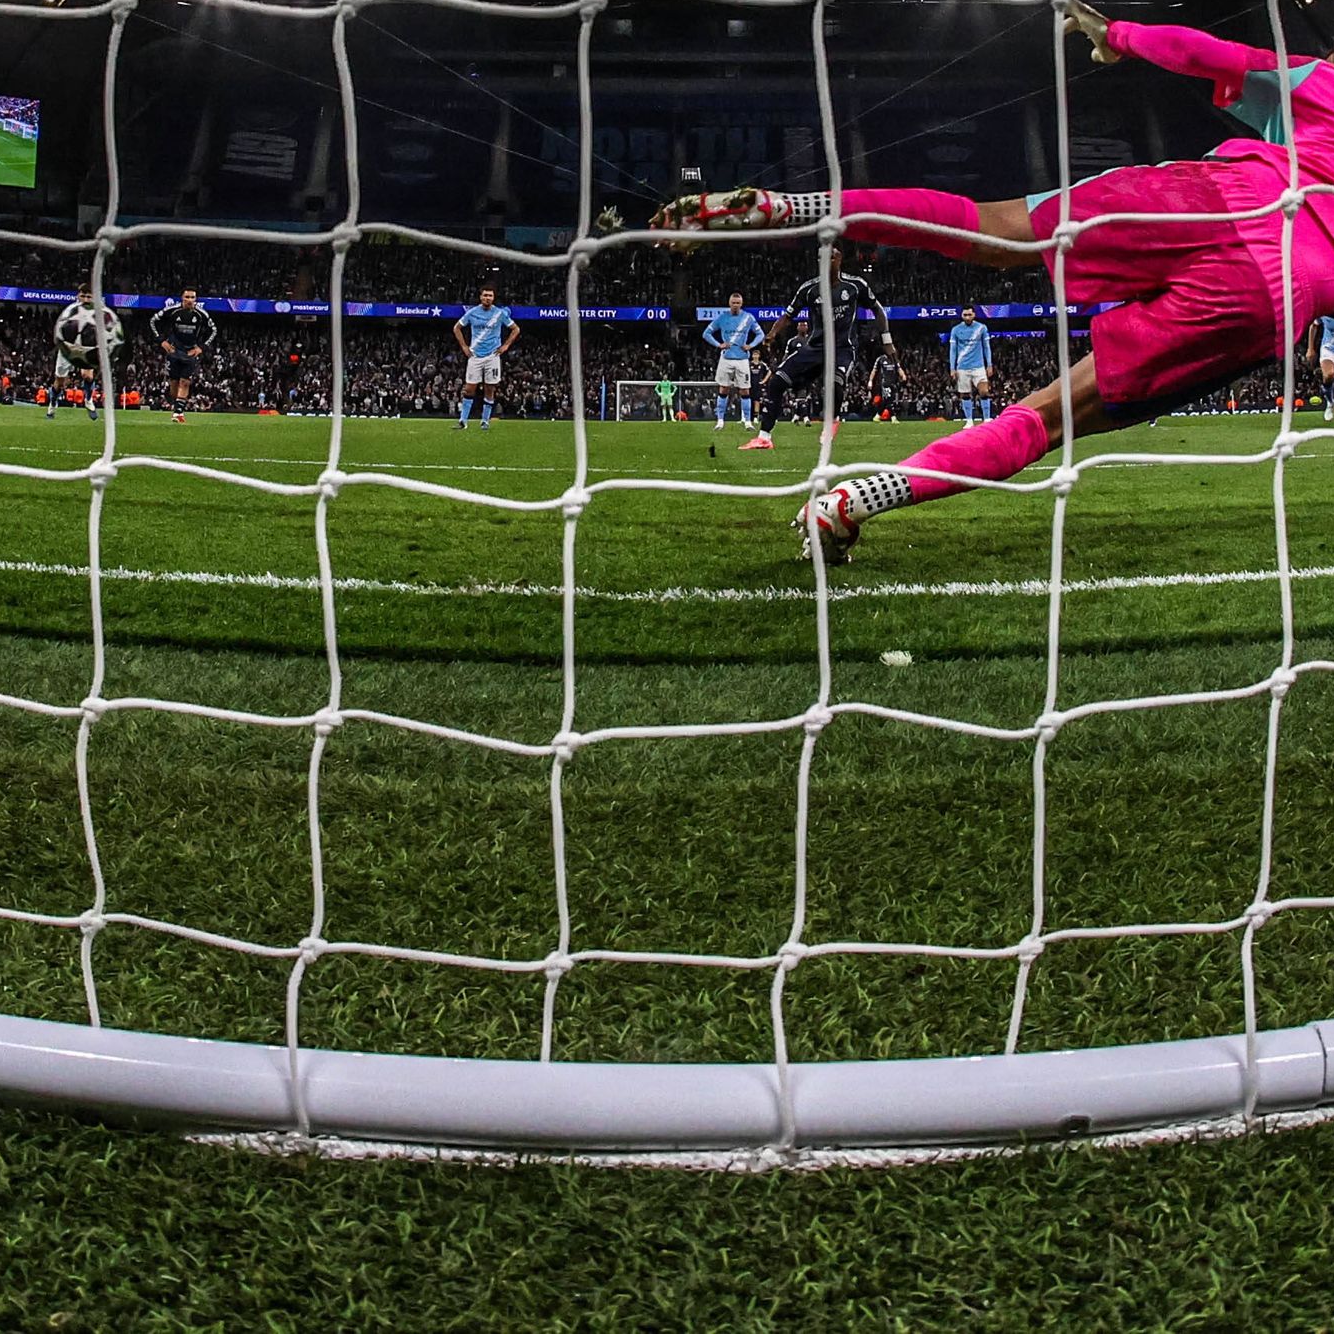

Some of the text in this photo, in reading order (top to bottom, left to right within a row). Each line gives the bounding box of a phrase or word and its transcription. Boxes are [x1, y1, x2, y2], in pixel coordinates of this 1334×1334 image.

[23, 292, 40, 300] UEFA
[293, 303, 329, 311] mastercard
[396, 306, 429, 315] Heineken
[597, 309, 617, 318] CITY
[758, 310, 780, 319] REAL
[931, 308, 957, 316] PS5
